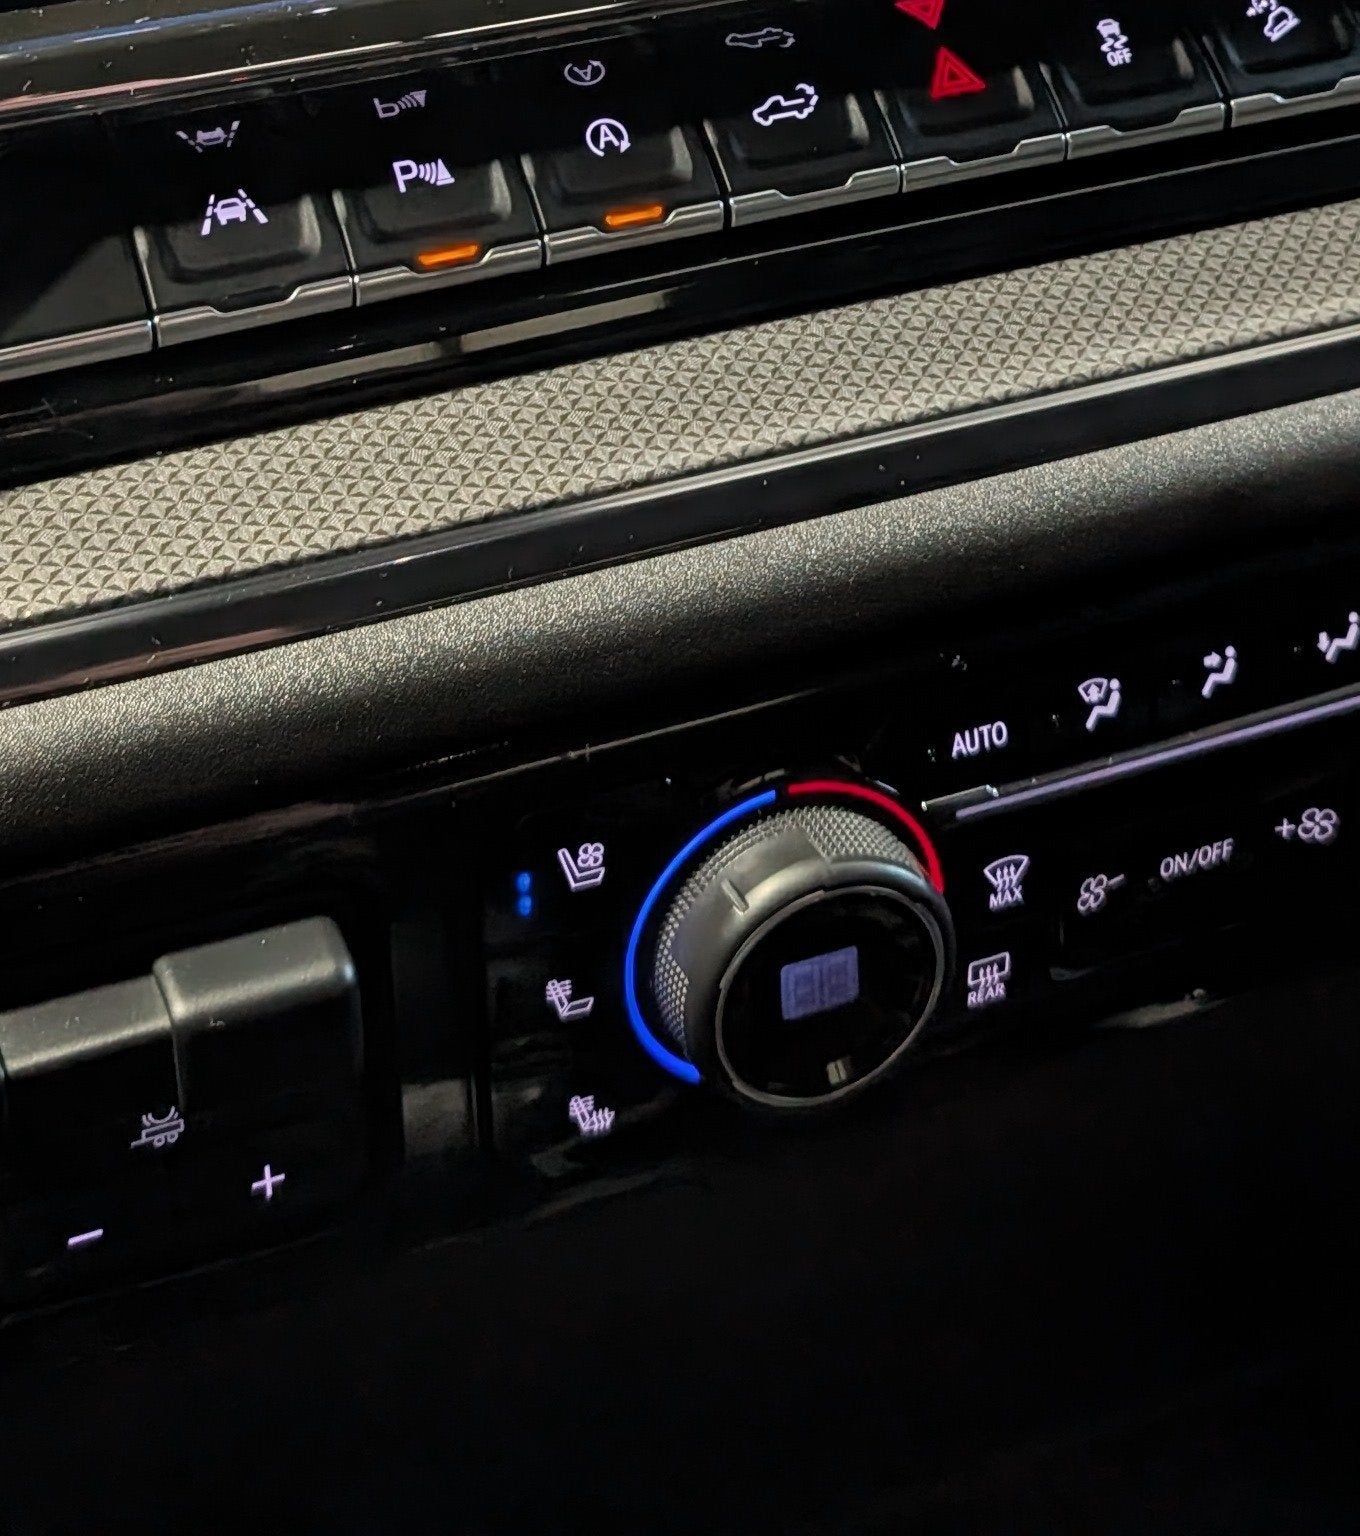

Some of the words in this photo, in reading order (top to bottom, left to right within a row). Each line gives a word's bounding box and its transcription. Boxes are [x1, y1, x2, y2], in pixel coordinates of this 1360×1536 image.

[1107, 48, 1132, 66] OFF
[951, 721, 1008, 759] AUTO
[1159, 839, 1234, 881] ON/OFF
[989, 886, 1023, 909] MAX
[967, 981, 1005, 1007] REAR
